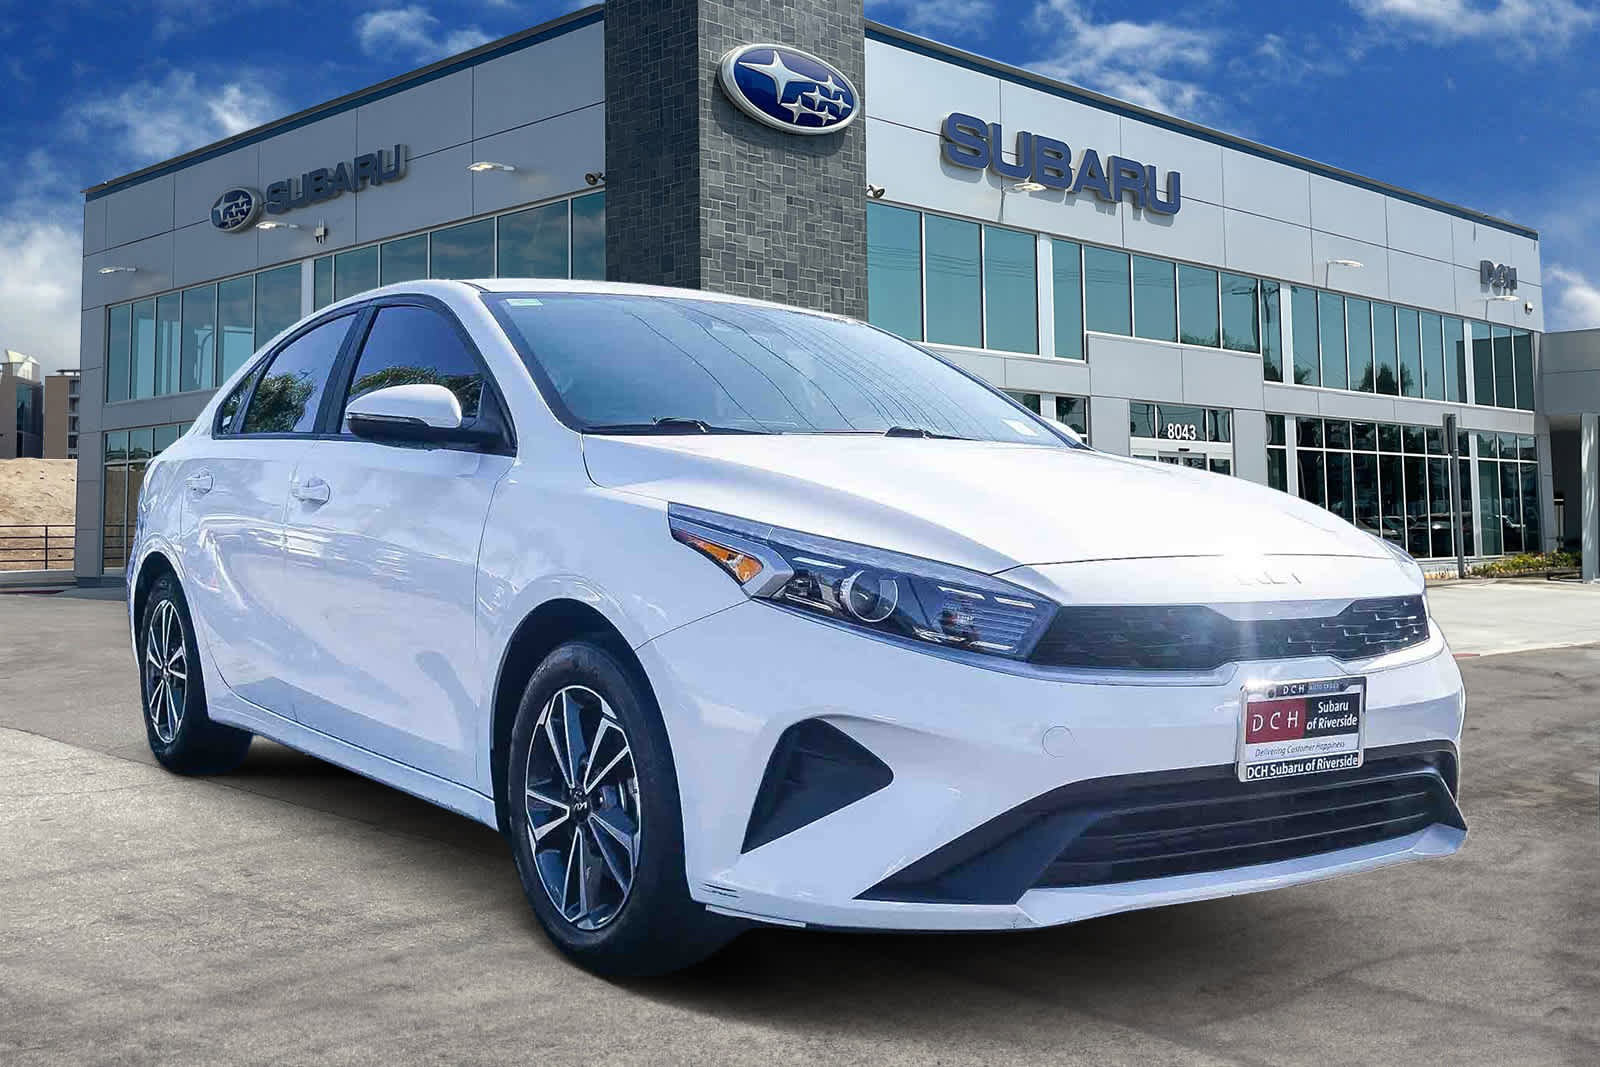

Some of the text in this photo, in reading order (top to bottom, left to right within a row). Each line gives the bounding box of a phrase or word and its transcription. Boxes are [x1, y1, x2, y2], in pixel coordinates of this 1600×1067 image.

[943, 112, 1181, 215] SUBARU
[266, 144, 408, 215] SUBARU
[1167, 423, 1196, 440] 8043
[1318, 701, 1349, 713] Subaru
[1306, 713, 1358, 730] of Riverside
[1255, 741, 1345, 757] Delivering Customer Happiness
[1247, 754, 1358, 779] DCH Subaru of Riverside
